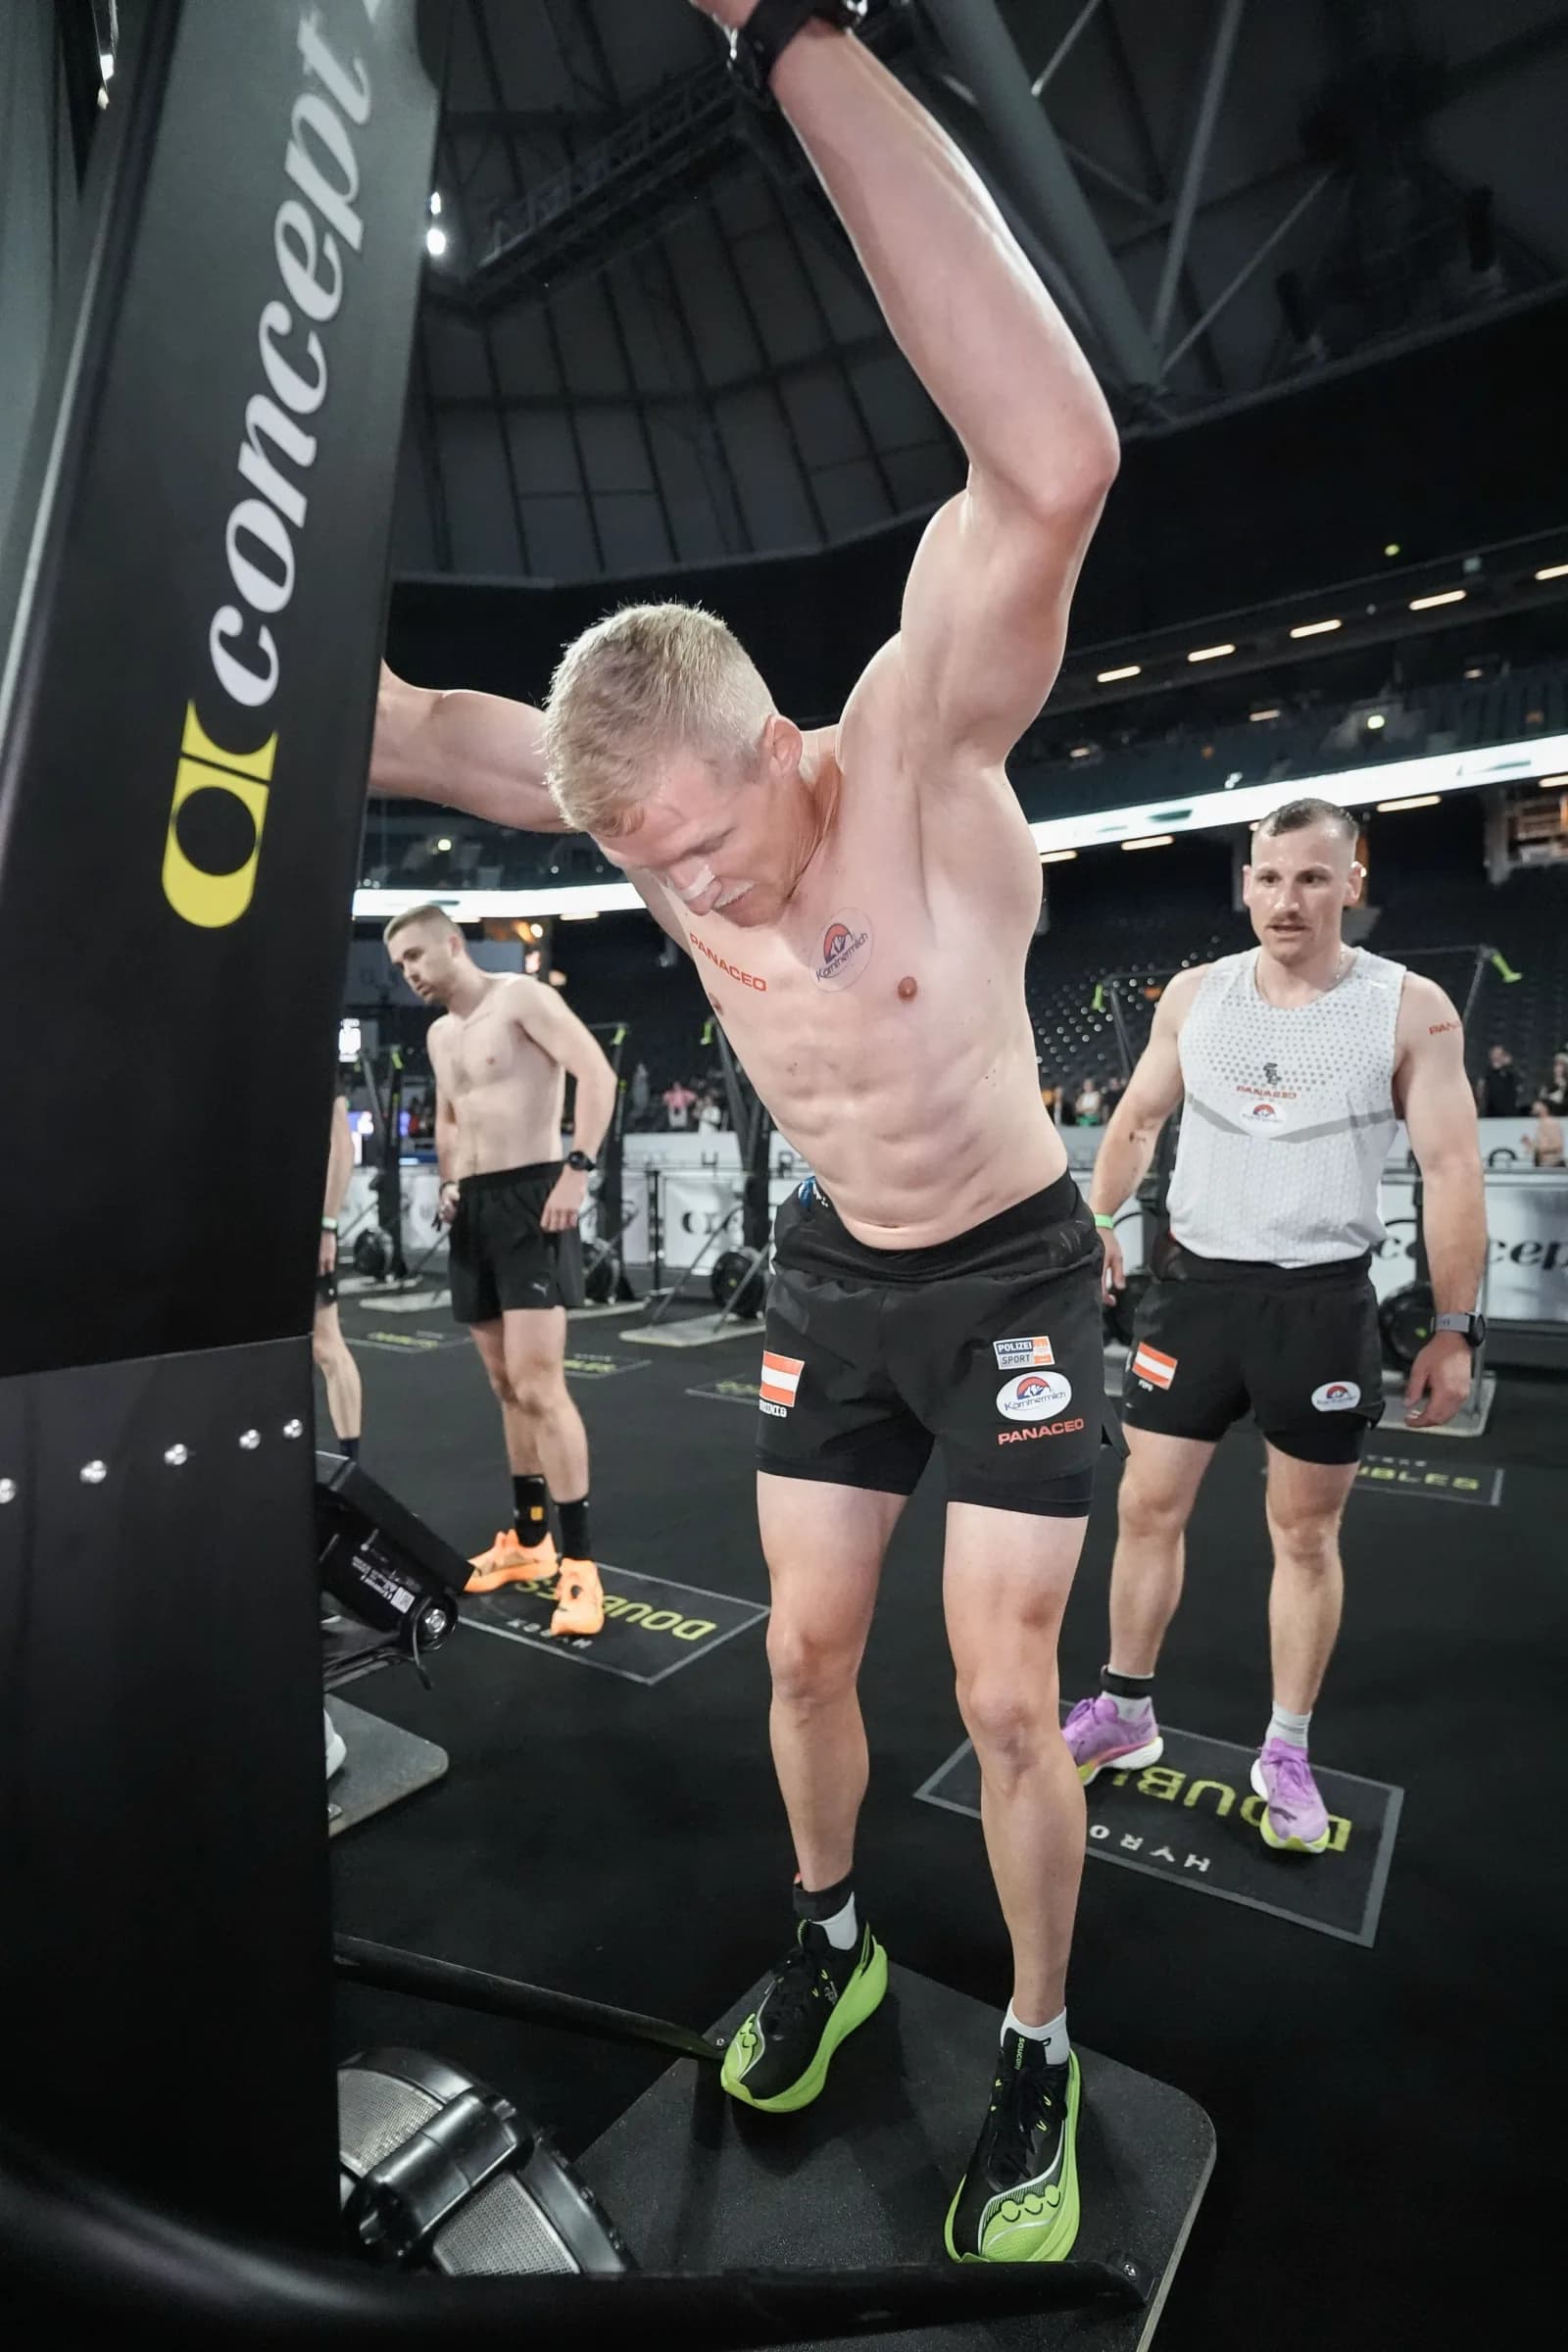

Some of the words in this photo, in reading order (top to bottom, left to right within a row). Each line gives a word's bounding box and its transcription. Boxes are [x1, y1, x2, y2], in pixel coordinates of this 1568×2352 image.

[209, 8, 372, 708] concept
[689, 932, 768, 993] PANACEO
[998, 1341, 1033, 1352] POLIZEI
[1002, 1353, 1031, 1365] SPORT
[998, 1418, 1085, 1446] PANACEO
[1089, 1825, 1211, 1873] HYRO
